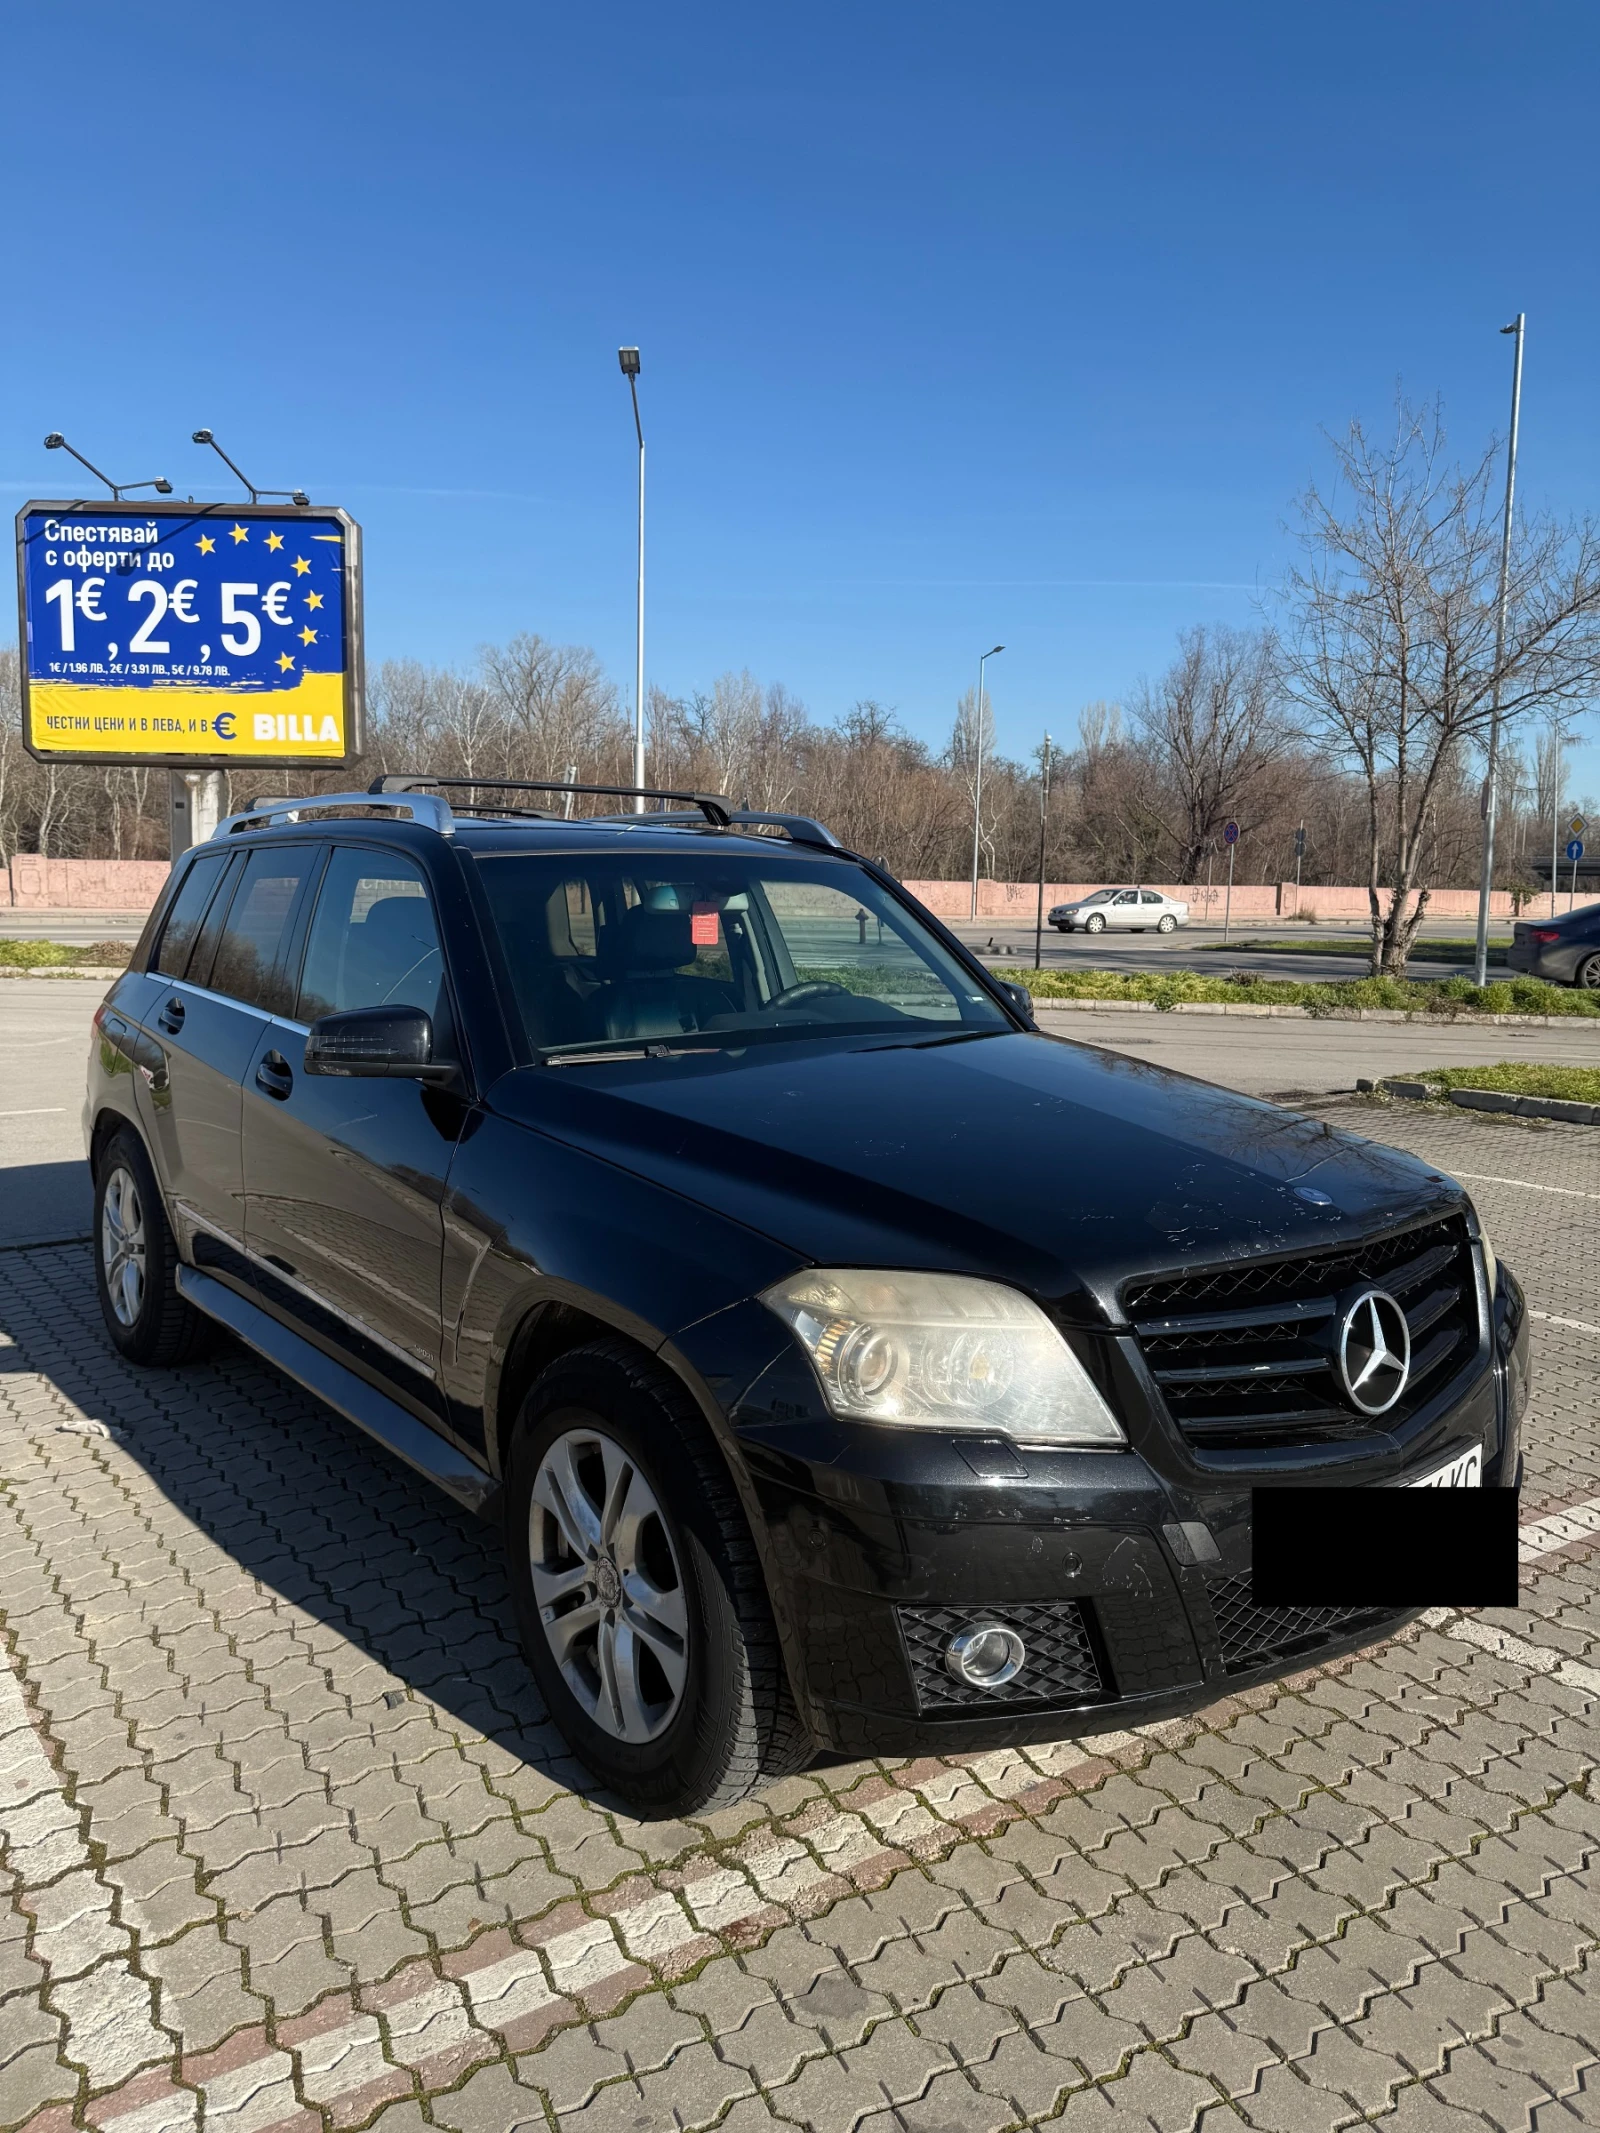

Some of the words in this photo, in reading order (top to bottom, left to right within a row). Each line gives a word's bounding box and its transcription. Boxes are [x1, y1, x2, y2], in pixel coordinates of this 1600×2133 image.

[44, 519, 158, 543] Спестявай
[45, 549, 58, 566] с
[63, 544, 142, 573] оферти
[146, 552, 175, 572] до
[221, 581, 294, 656] 5€
[49, 662, 61, 673] 1€
[69, 662, 88, 673] 1.96
[109, 663, 123, 674] 2€
[131, 664, 150, 674] 3.91
[172, 665, 185, 675] 5€
[193, 665, 213, 675] 9.78
[46, 716, 90, 730] ЧЕСТНИ
[94, 717, 124, 732] ЦЕНИ
[129, 717, 137, 731] И
[141, 718, 148, 731] В
[152, 718, 185, 734] ЛЕВА,
[188, 719, 197, 732] И
[200, 719, 208, 732] В
[211, 712, 238, 740] €
[253, 713, 340, 742] BILLA
